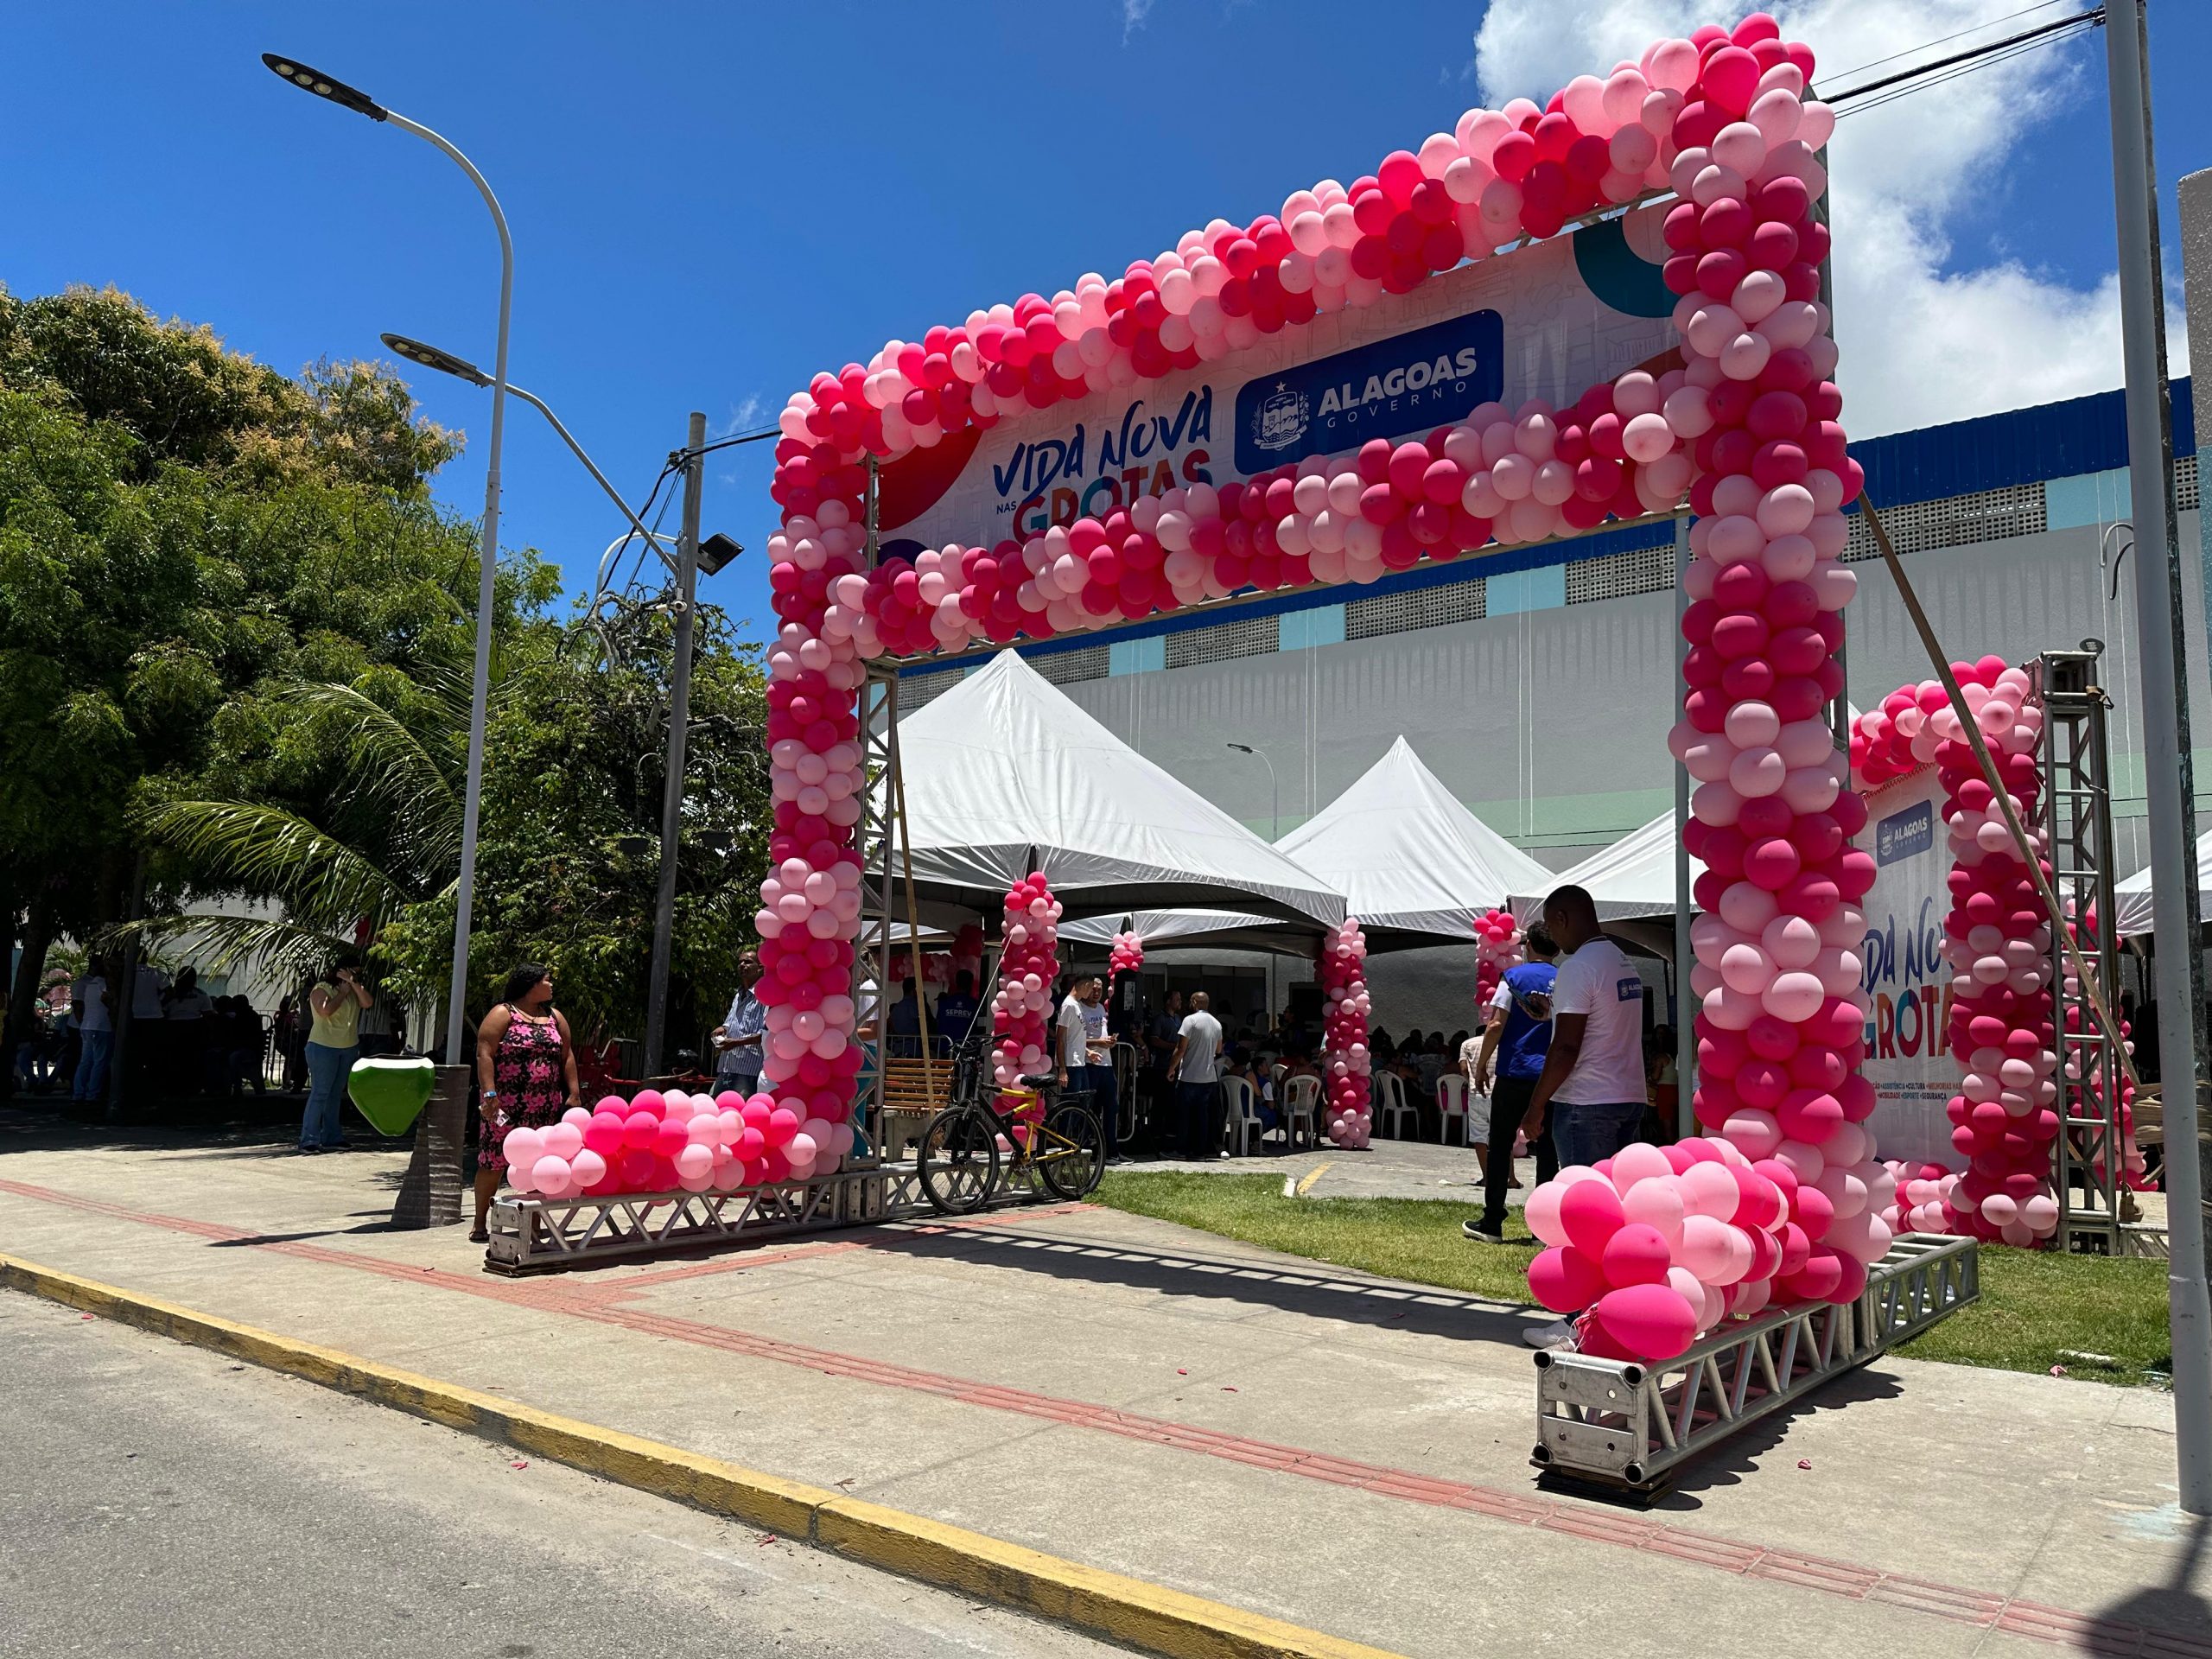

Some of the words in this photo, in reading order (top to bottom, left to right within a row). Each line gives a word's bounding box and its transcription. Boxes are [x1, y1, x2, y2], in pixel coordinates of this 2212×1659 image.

[1318, 347, 1477, 416] ALAGOAS
[1327, 381, 1466, 428] GOVERNO
[994, 423, 1085, 503] VIDA
[1098, 385, 1212, 475] NOVA
[996, 500, 1017, 515] NAS
[1013, 448, 1213, 544] GROTAS
[1894, 817, 1928, 842] ALAGOAS
